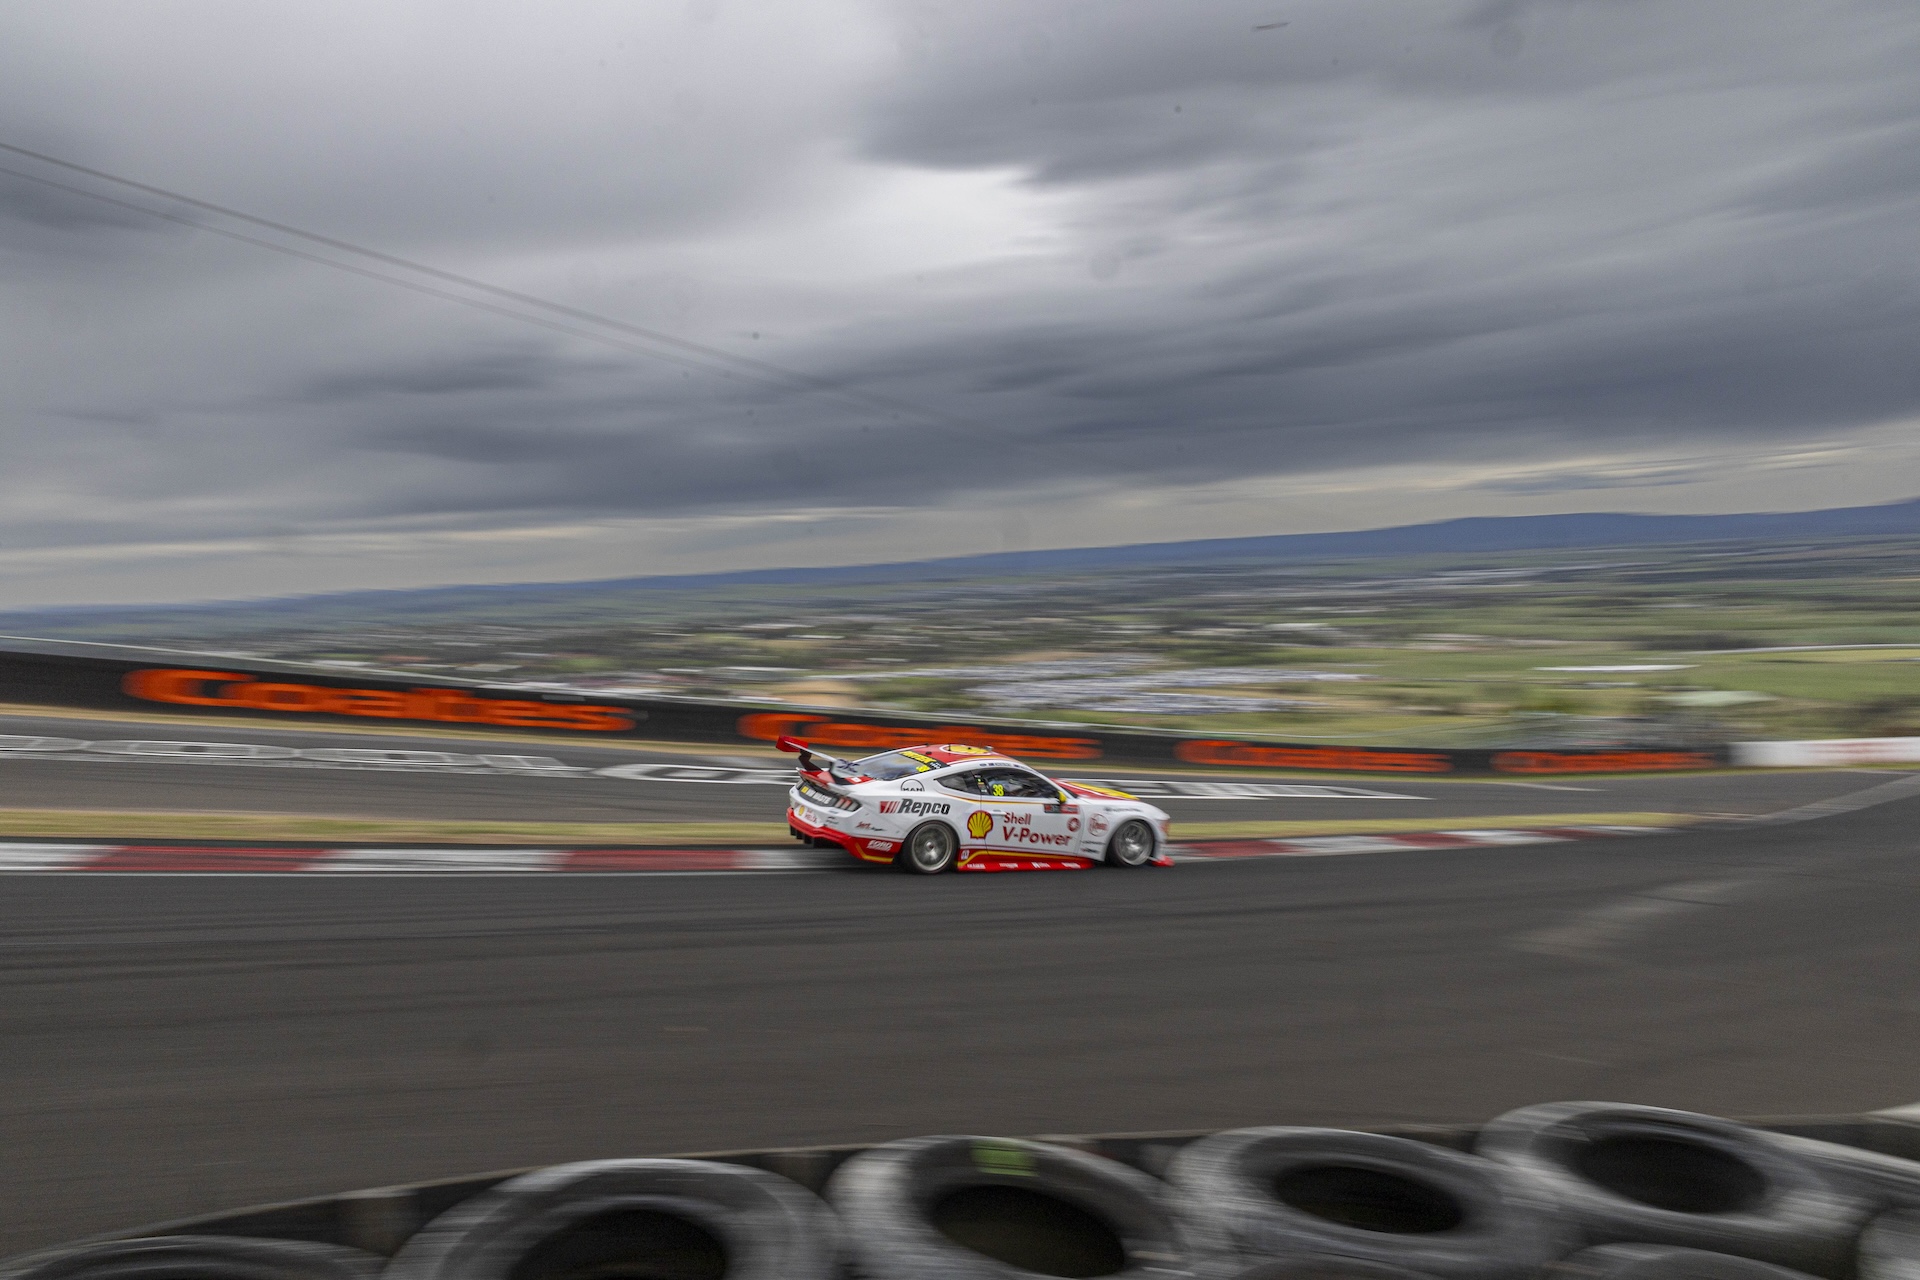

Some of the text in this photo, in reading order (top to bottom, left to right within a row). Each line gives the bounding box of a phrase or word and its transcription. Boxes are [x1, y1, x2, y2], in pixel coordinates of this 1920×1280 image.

[122, 669, 635, 731] Coates
[992, 784, 1005, 797] 38
[898, 799, 951, 816] Repco
[1003, 812, 1032, 825] Shell
[1002, 826, 1073, 846] V-Power
